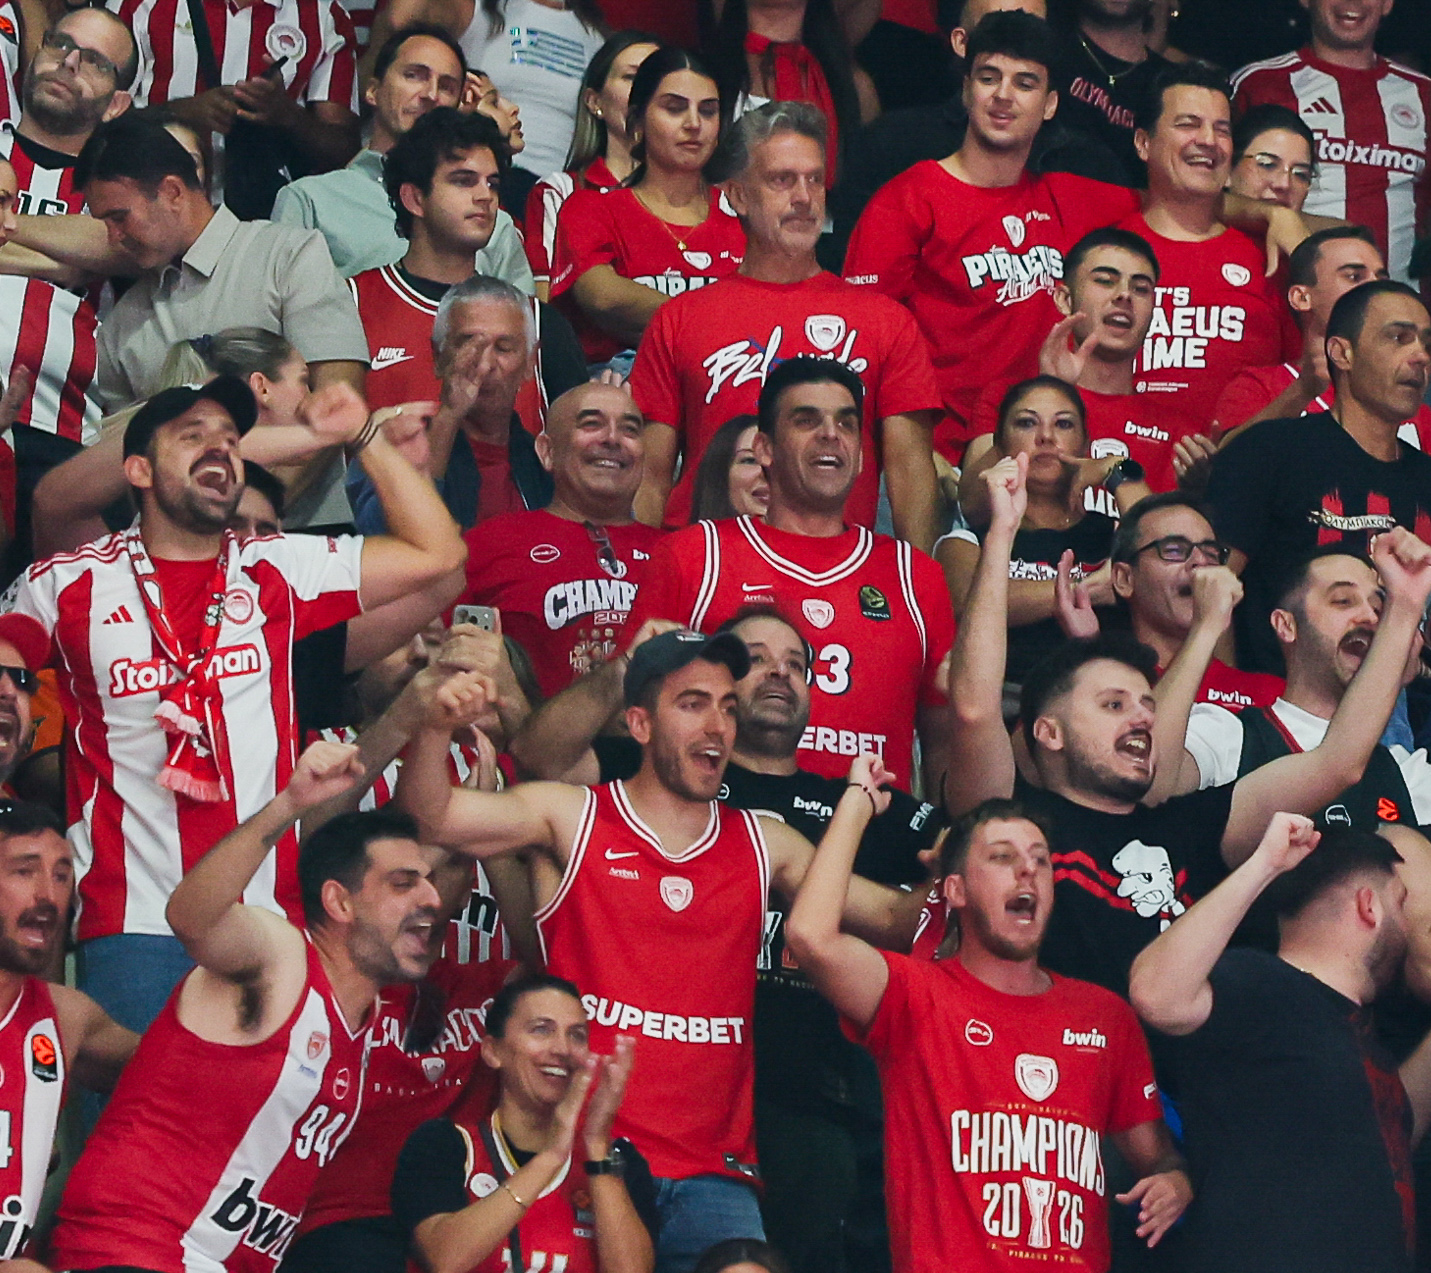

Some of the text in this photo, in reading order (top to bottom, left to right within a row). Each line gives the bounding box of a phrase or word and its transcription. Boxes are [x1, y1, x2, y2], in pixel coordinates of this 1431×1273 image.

[962, 247, 1066, 290] PIRAEUS
[1153, 285, 1191, 307] T'S
[1147, 305, 1247, 344] AEUS
[377, 347, 406, 361] NIKE
[701, 325, 869, 405] Belde
[1132, 336, 1209, 374] IME
[1124, 420, 1170, 442] bwin
[544, 578, 639, 631] CHAMP
[805, 643, 853, 695] 3
[1207, 687, 1253, 708] bwin
[797, 726, 888, 764] ERBET
[792, 794, 835, 818] bwn
[579, 988, 745, 1045] SUPERBET
[1062, 1027, 1107, 1048] bwin
[294, 1103, 348, 1169] 94
[951, 1109, 1106, 1197] CHAMPIONS
[982, 1182, 1085, 1251] 20 26
